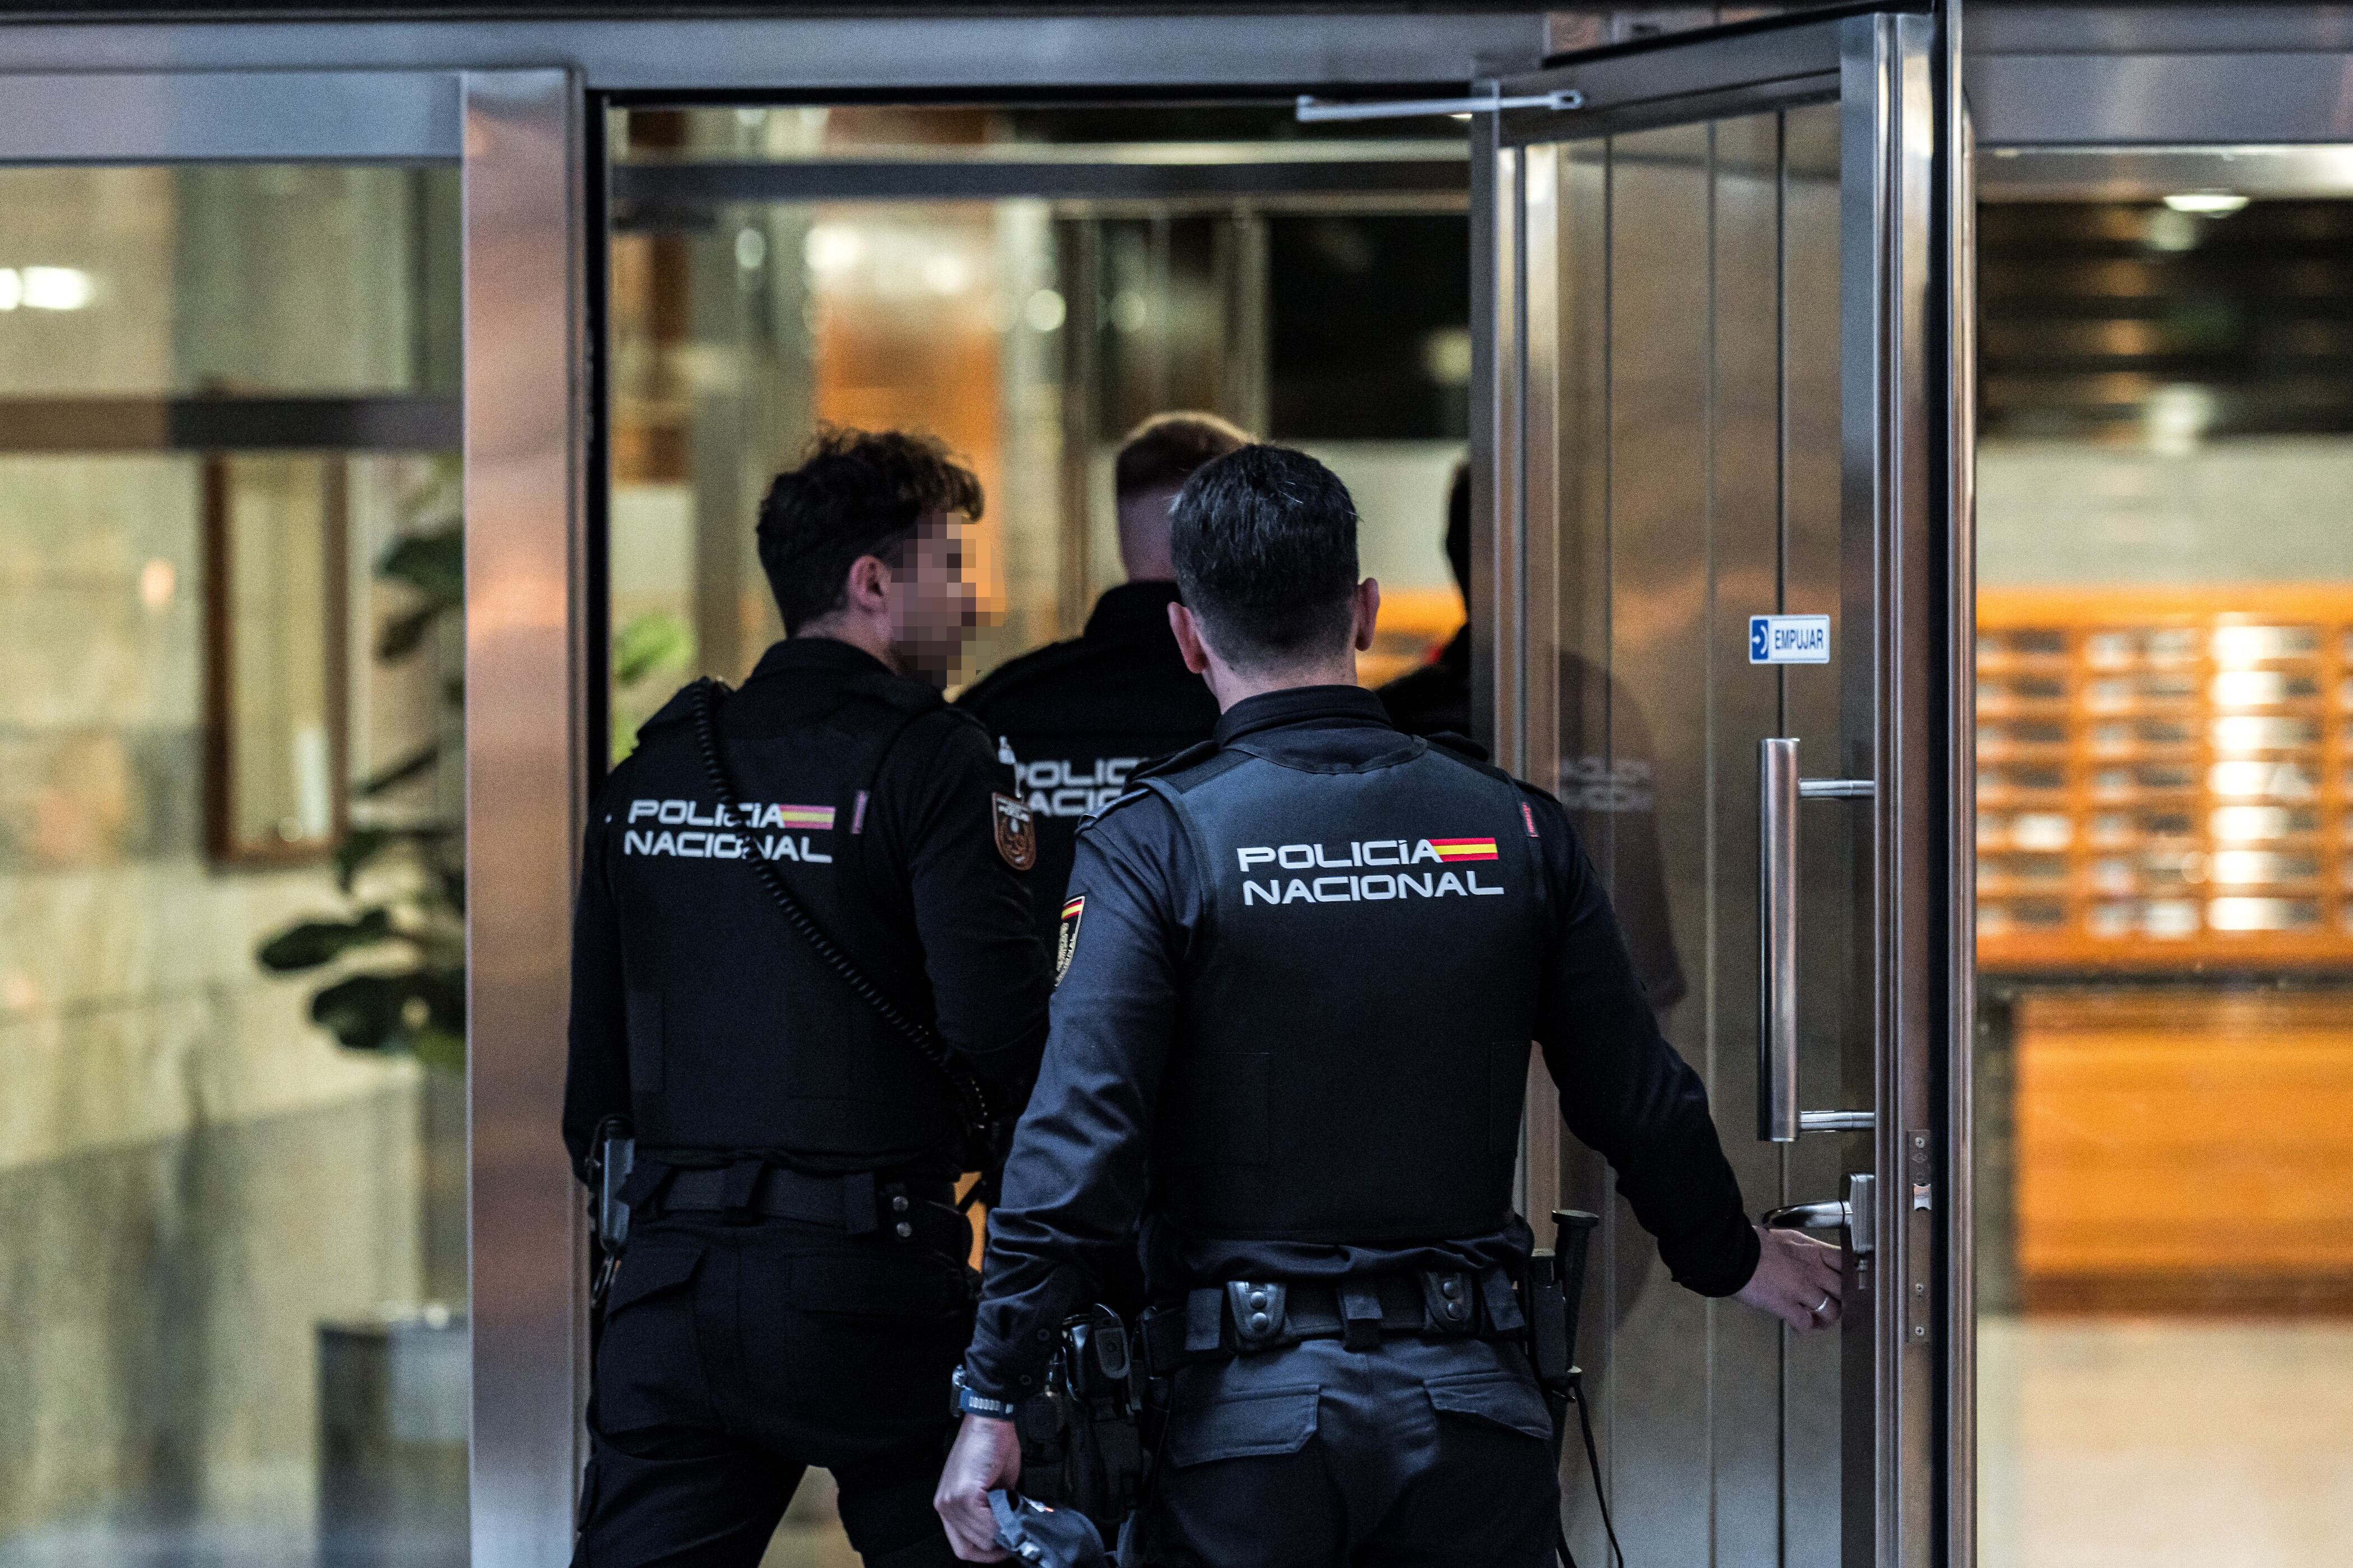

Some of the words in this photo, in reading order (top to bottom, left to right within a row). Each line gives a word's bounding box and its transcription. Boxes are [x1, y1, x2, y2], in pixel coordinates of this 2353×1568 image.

[1774, 629, 1824, 650] EMPUJAR
[624, 830, 833, 863] NACIONAL
[1236, 839, 1443, 872] POLICÍA
[1242, 871, 1505, 906] NACIONAL
